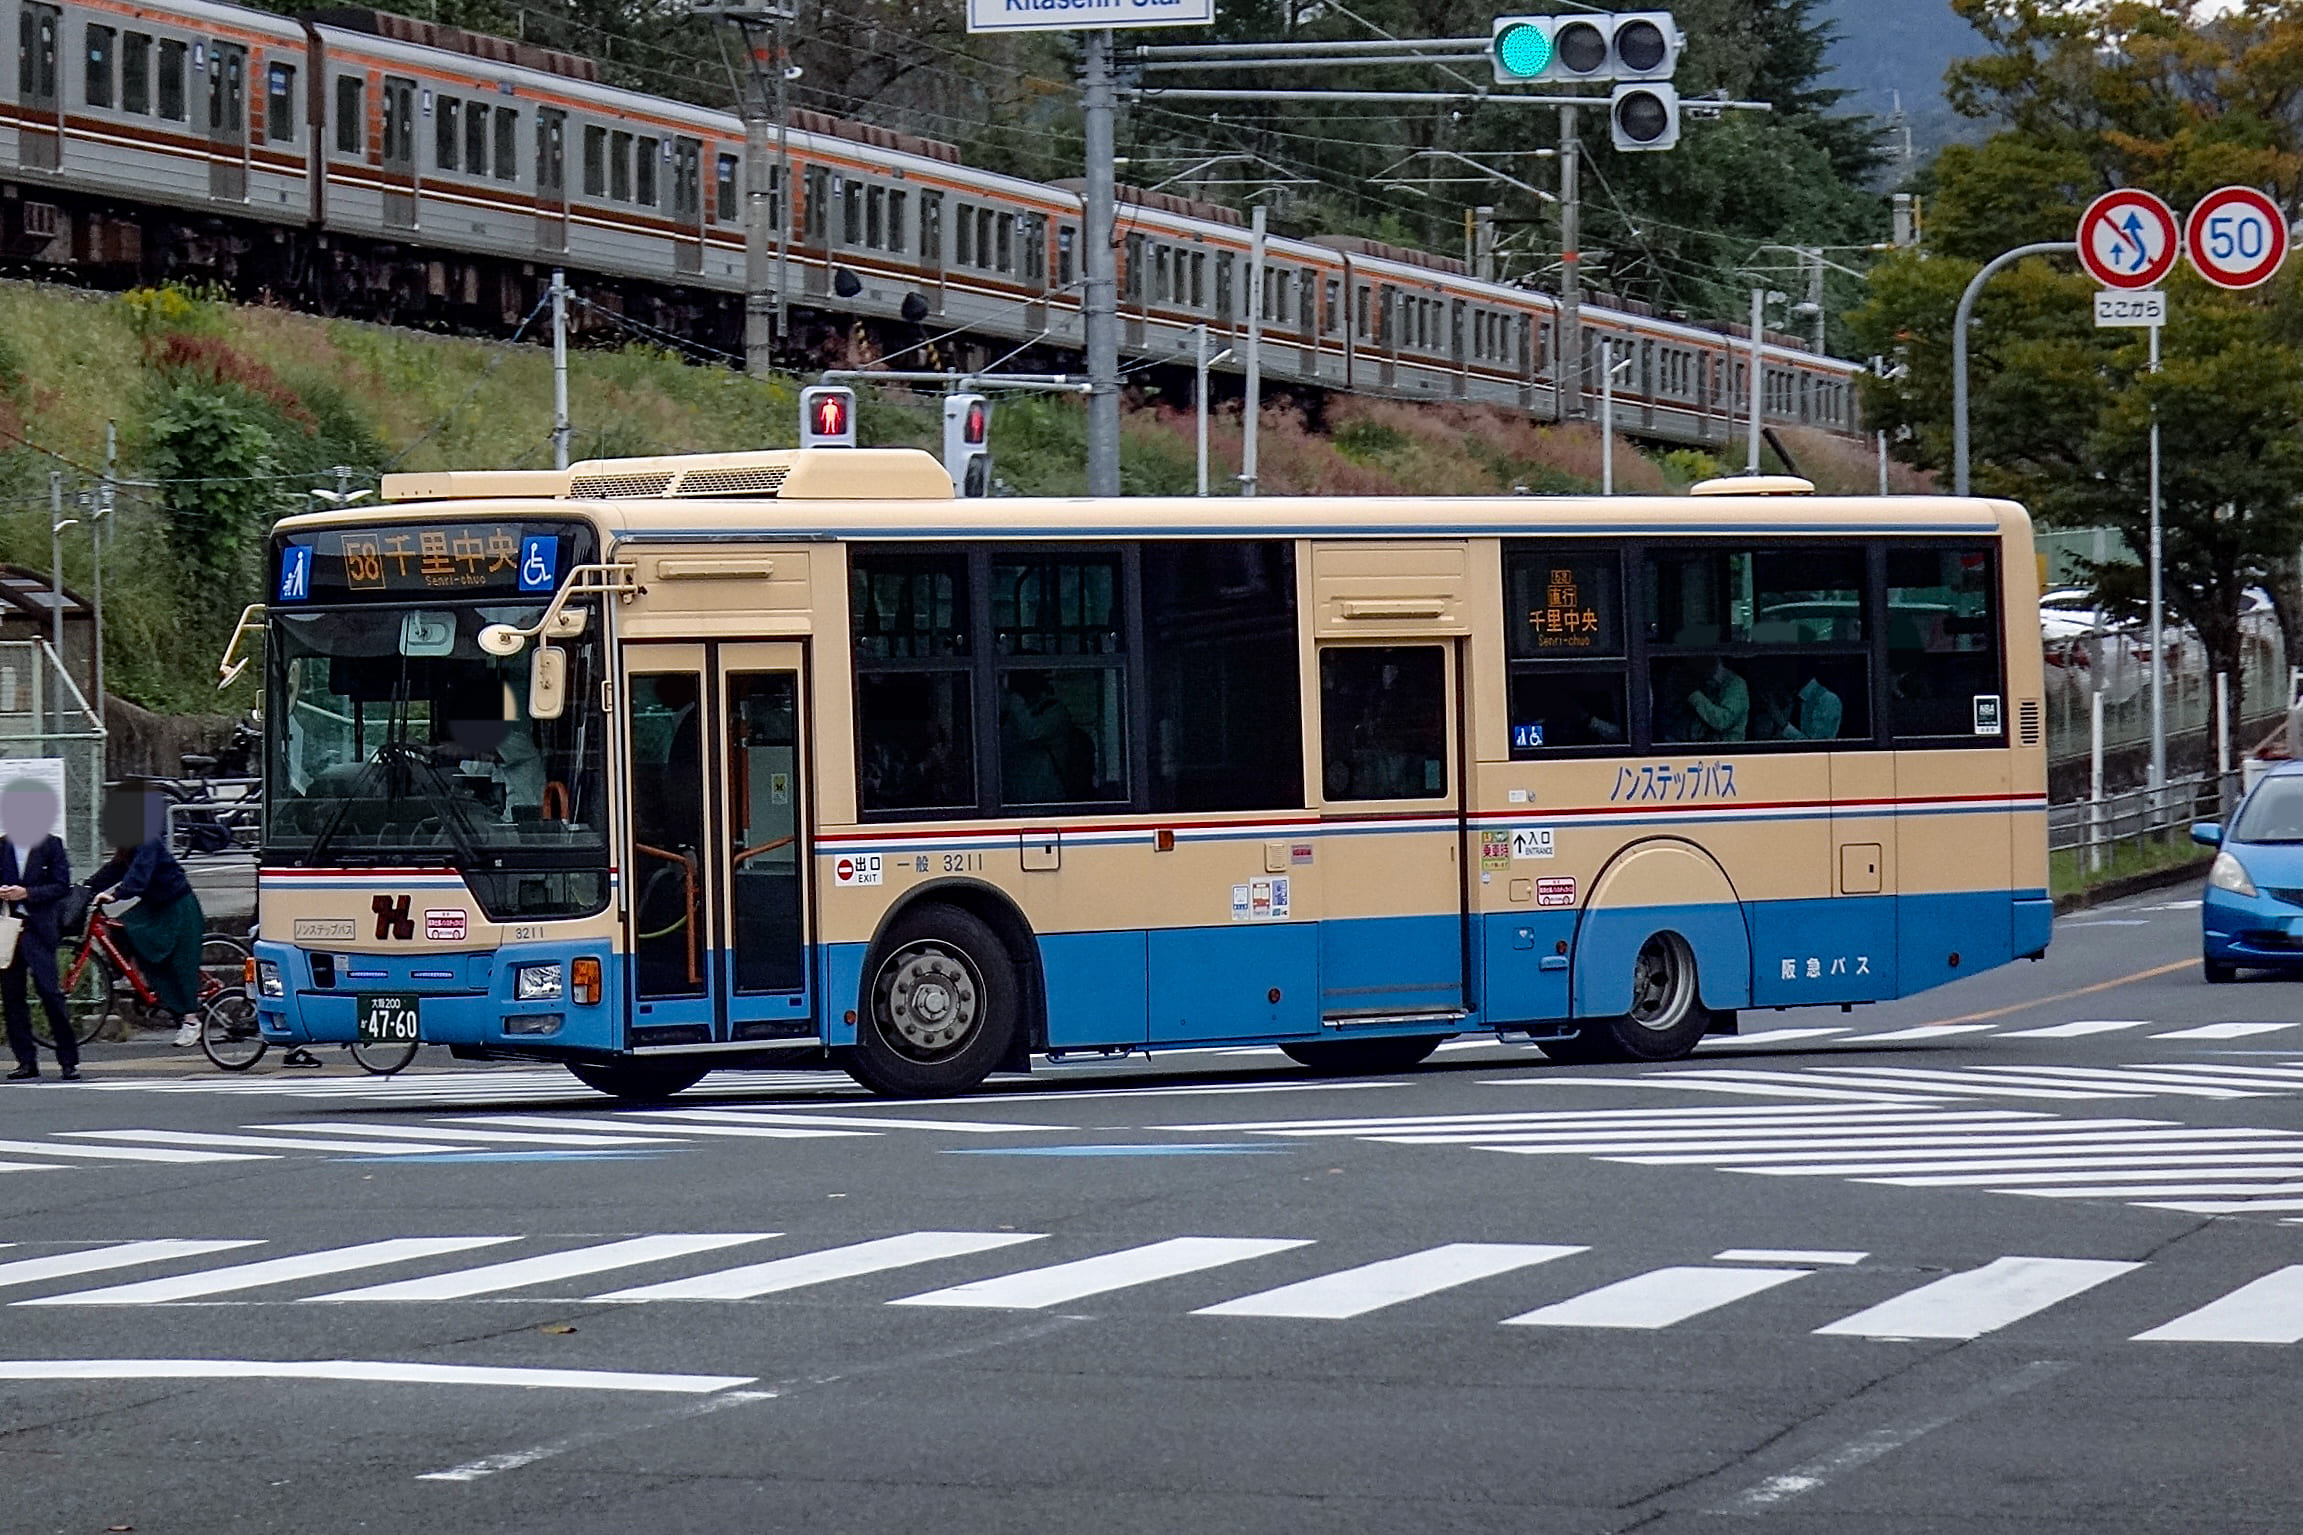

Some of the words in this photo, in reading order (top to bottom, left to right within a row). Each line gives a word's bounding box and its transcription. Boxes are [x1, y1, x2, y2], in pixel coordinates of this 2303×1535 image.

[2210, 217, 2263, 259] 50
[2099, 301, 2161, 319] ここから
[345, 541, 380, 581] 58
[385, 528, 518, 577] 千里中央
[425, 575, 487, 587] Senri-chuo
[1550, 587, 1575, 606] 直行
[1529, 607, 1598, 633] 千里中央
[1611, 760, 1737, 801] ノンステップバス
[1528, 831, 1550, 845] 入口
[1525, 847, 1553, 856] ENTRANCE
[855, 856, 881, 872] 出口
[897, 855, 929, 873] 一般
[943, 853, 983, 872] 3211
[858, 873, 878, 883] EXIT
[297, 923, 353, 936] ノンステップバス
[516, 926, 545, 940] 3211
[1781, 957, 1871, 980] 阪急バス
